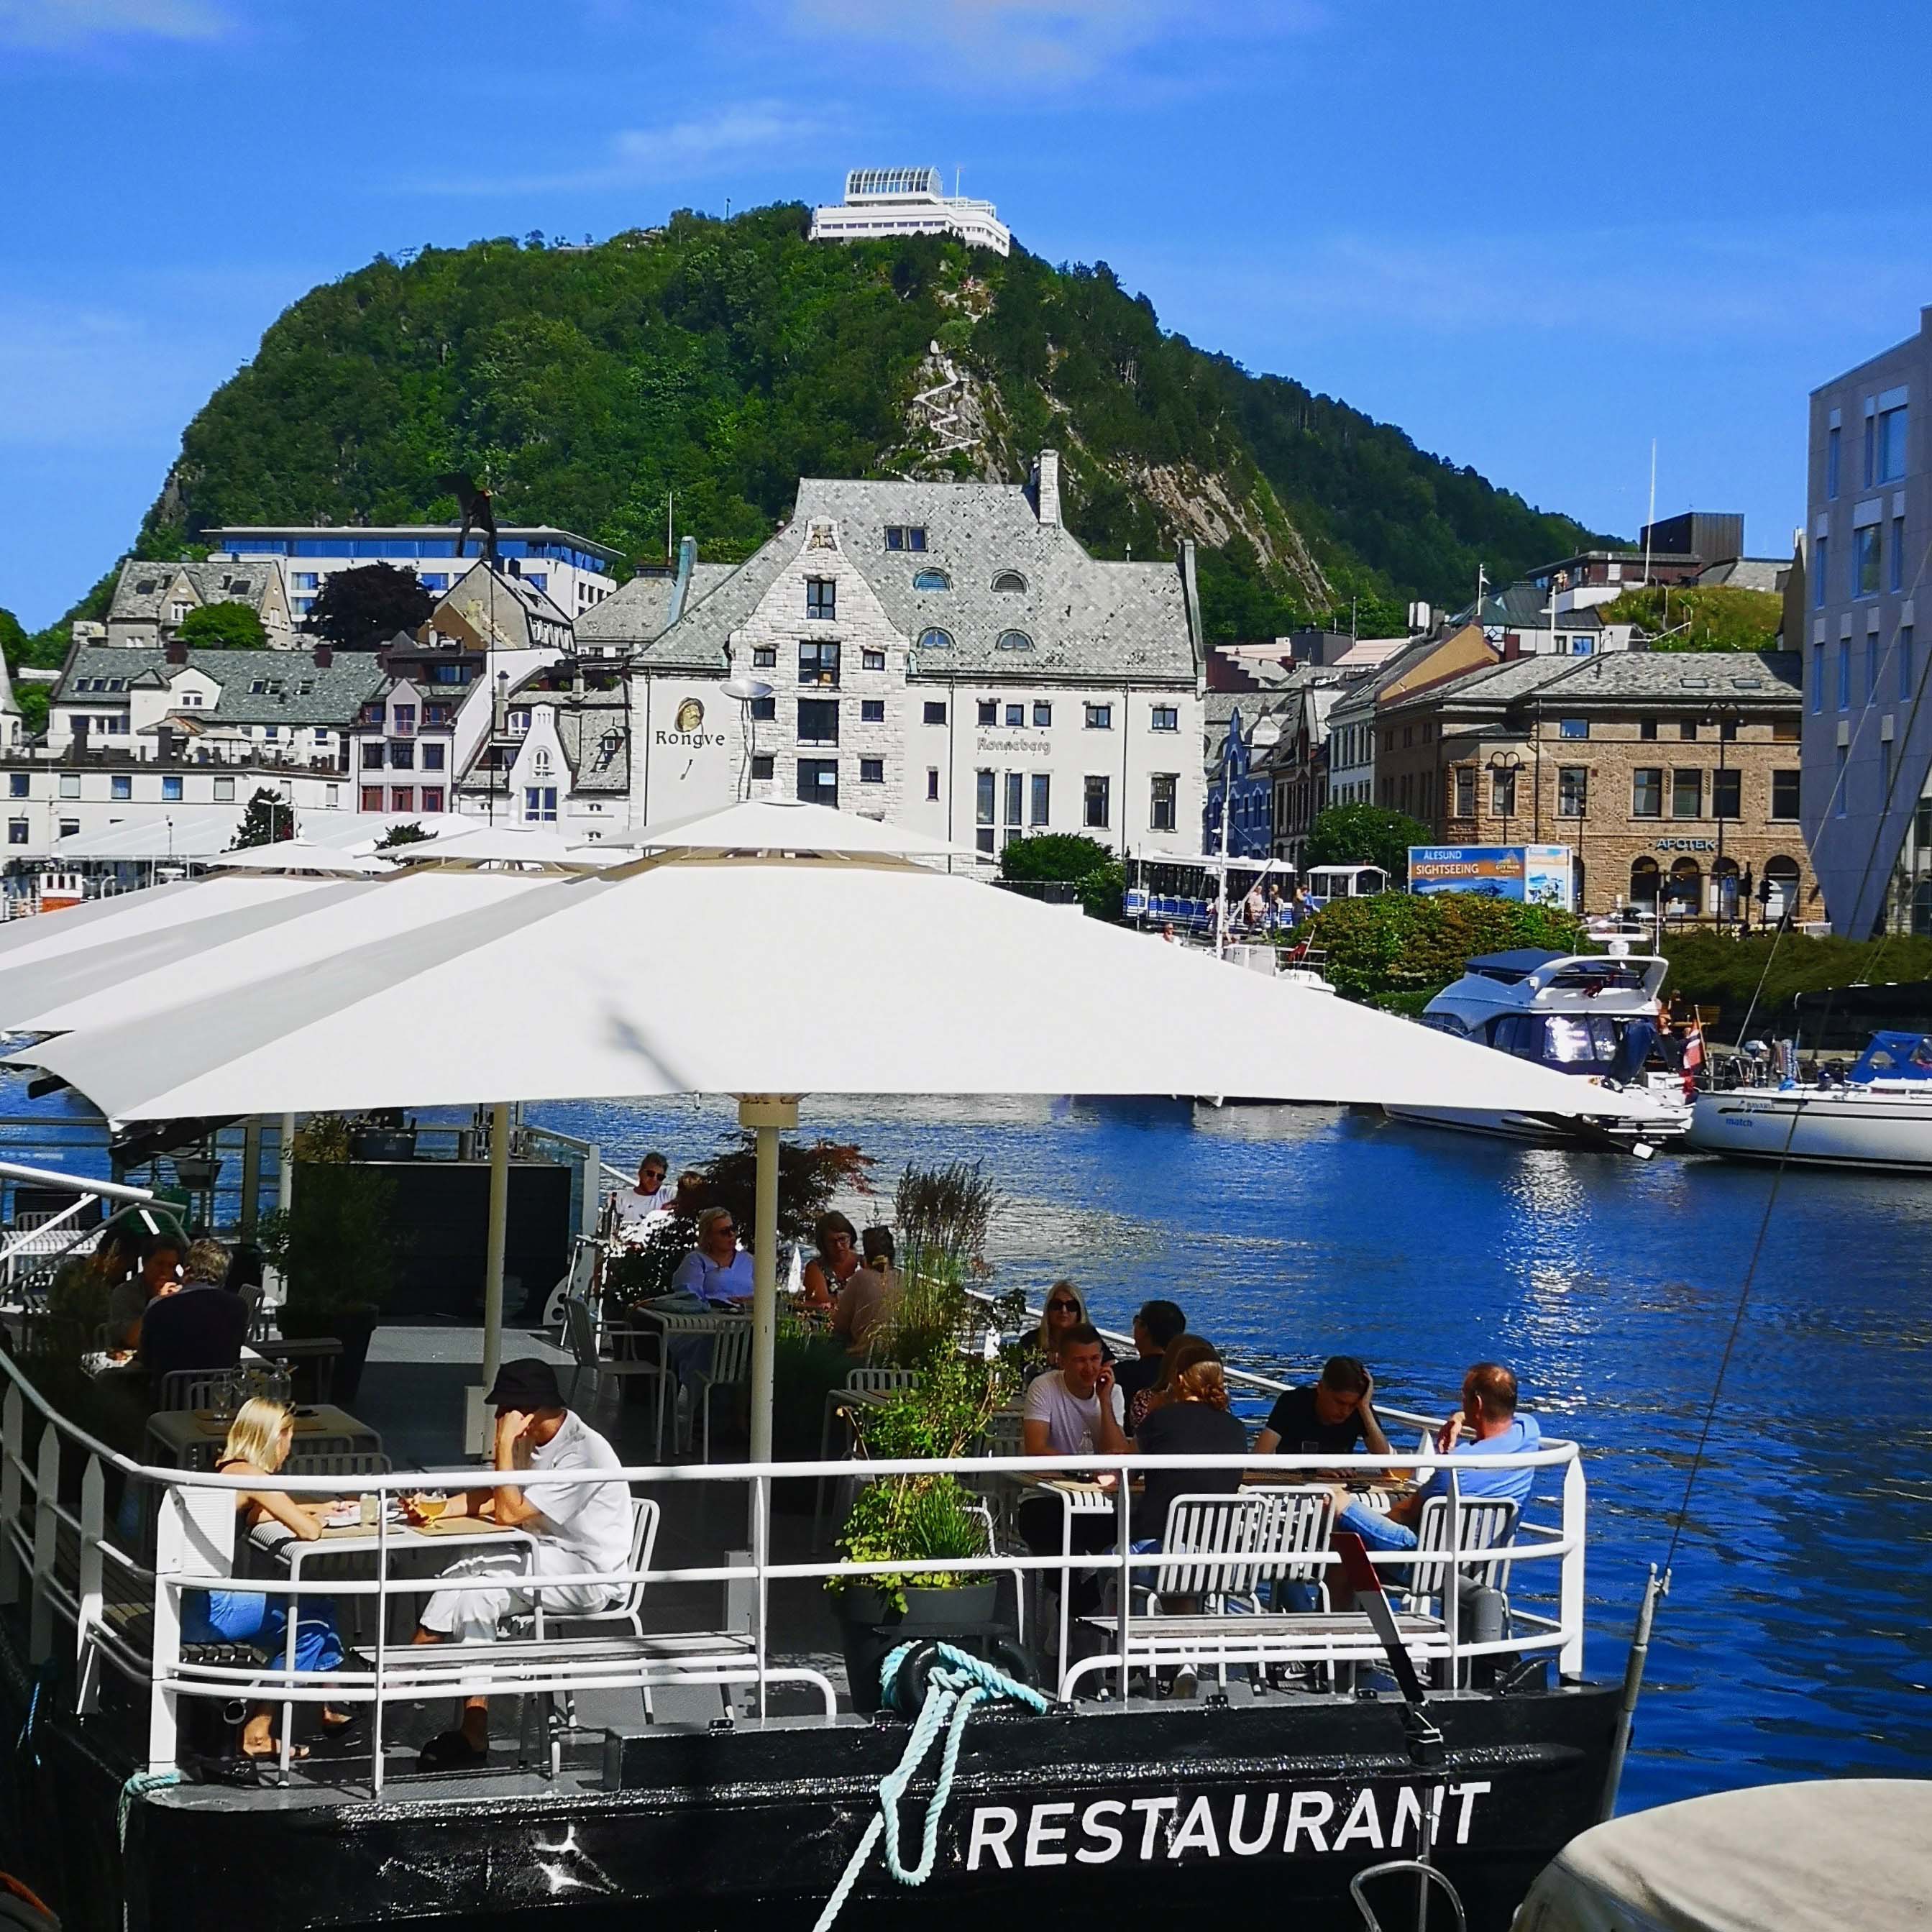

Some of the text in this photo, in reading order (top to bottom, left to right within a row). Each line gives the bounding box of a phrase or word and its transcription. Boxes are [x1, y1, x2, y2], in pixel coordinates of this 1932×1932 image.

[656, 731, 725, 748] Rongve
[1657, 839, 1715, 851] APOTEK
[1416, 864, 1479, 875] SIGHTSEEING
[967, 1781, 1491, 1870] RESTAURANT
